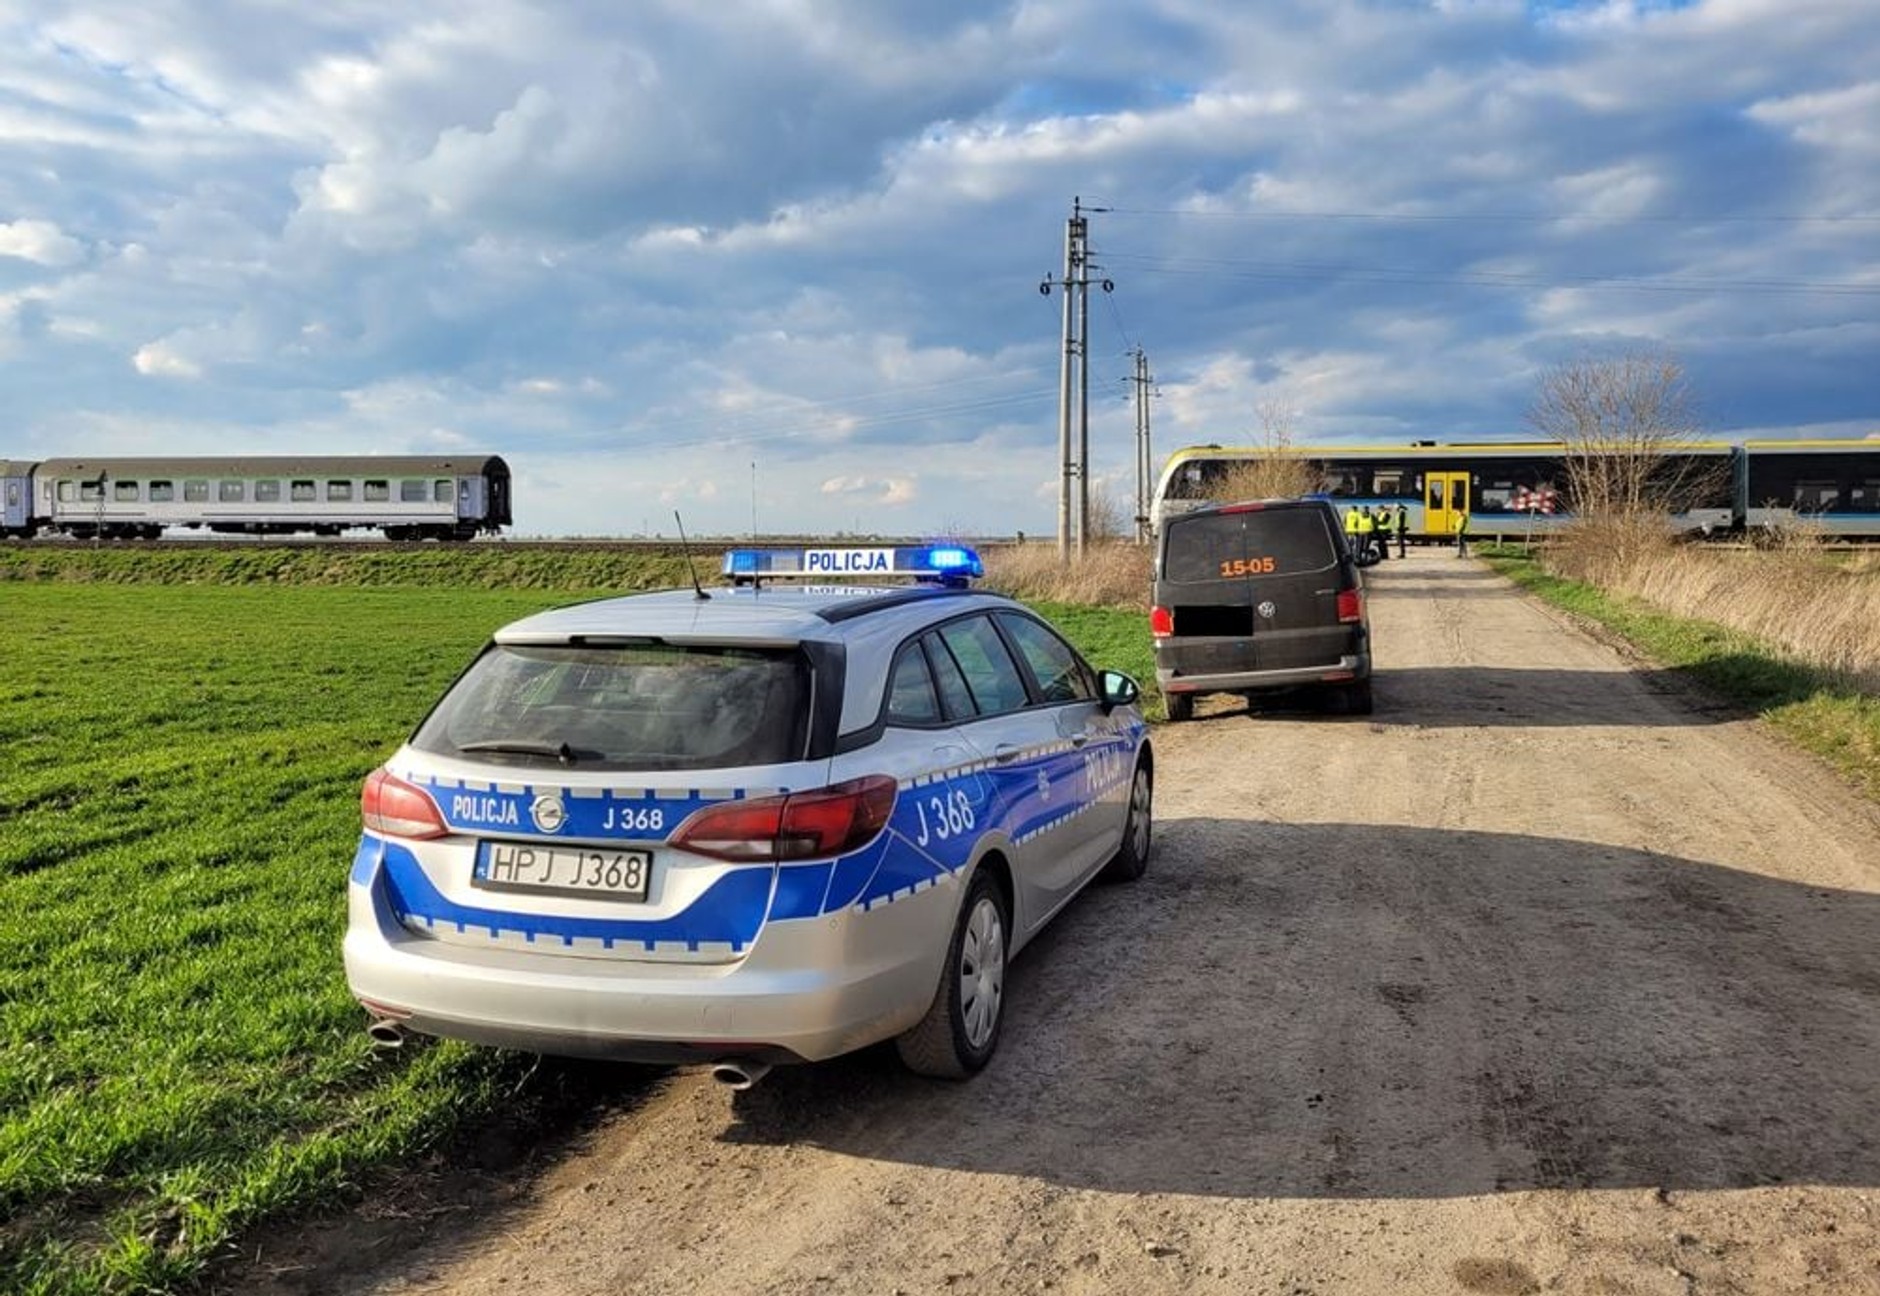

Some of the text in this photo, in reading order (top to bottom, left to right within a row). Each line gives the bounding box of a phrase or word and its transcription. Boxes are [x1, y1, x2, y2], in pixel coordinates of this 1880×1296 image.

[808, 552, 889, 571] POLICJA
[1220, 556, 1276, 577] 15-05
[452, 796, 519, 825] POLICJA
[602, 807, 664, 830] J 368
[916, 789, 976, 847] J 368
[493, 848, 642, 889] HPJ J368
